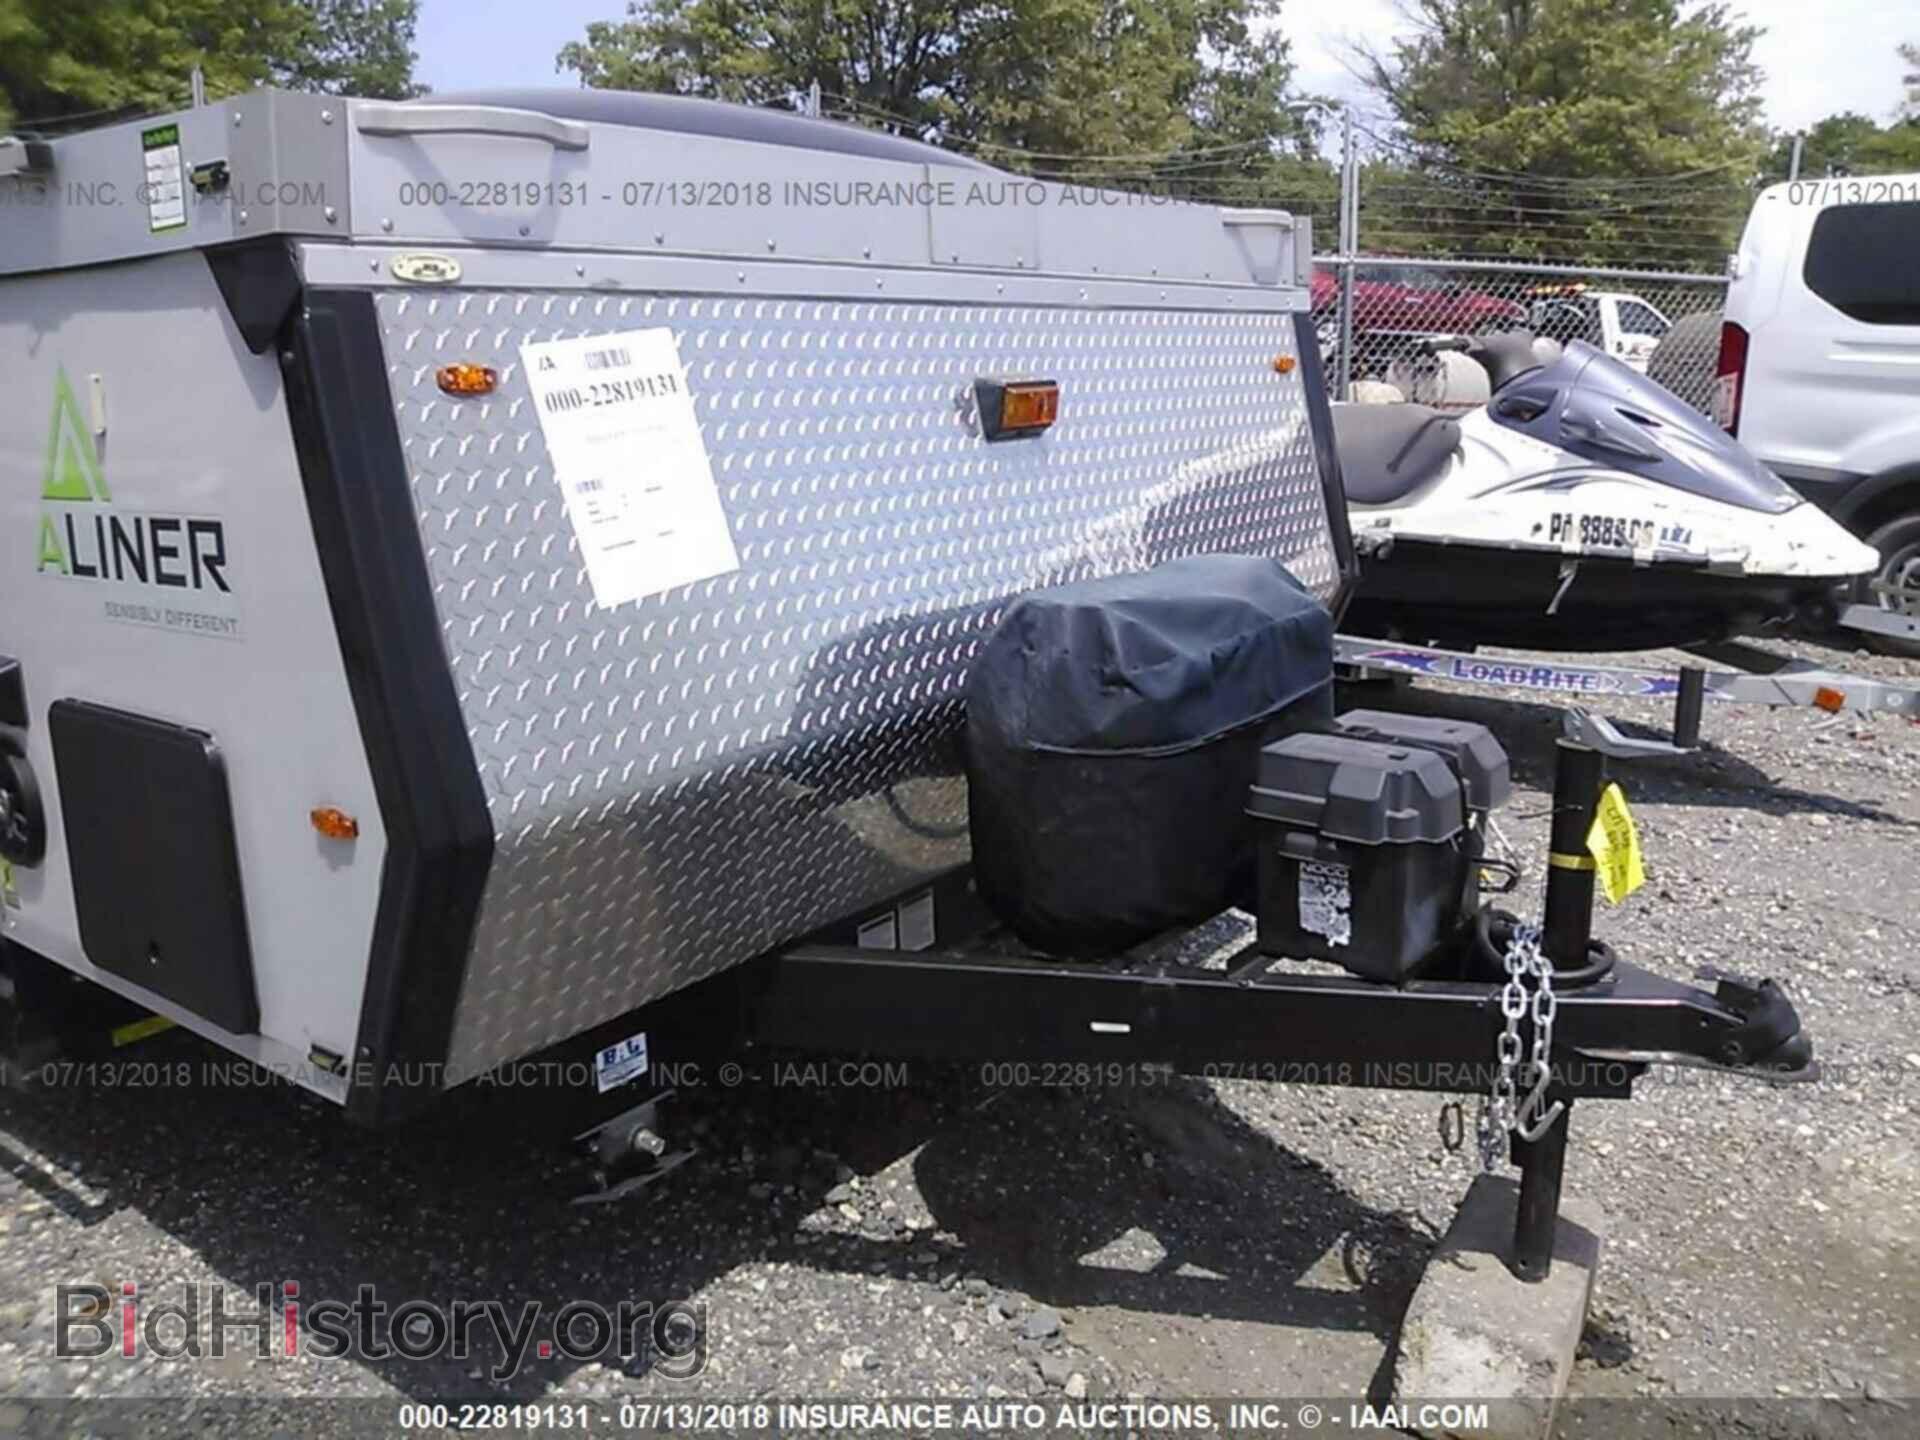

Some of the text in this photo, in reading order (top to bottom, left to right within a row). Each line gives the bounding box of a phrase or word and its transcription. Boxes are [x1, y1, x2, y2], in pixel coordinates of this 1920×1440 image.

[544, 372, 679, 414] 000-22819131
[37, 511, 232, 593] ALINER
[104, 600, 239, 635] SENSIBLY DIFFERENT
